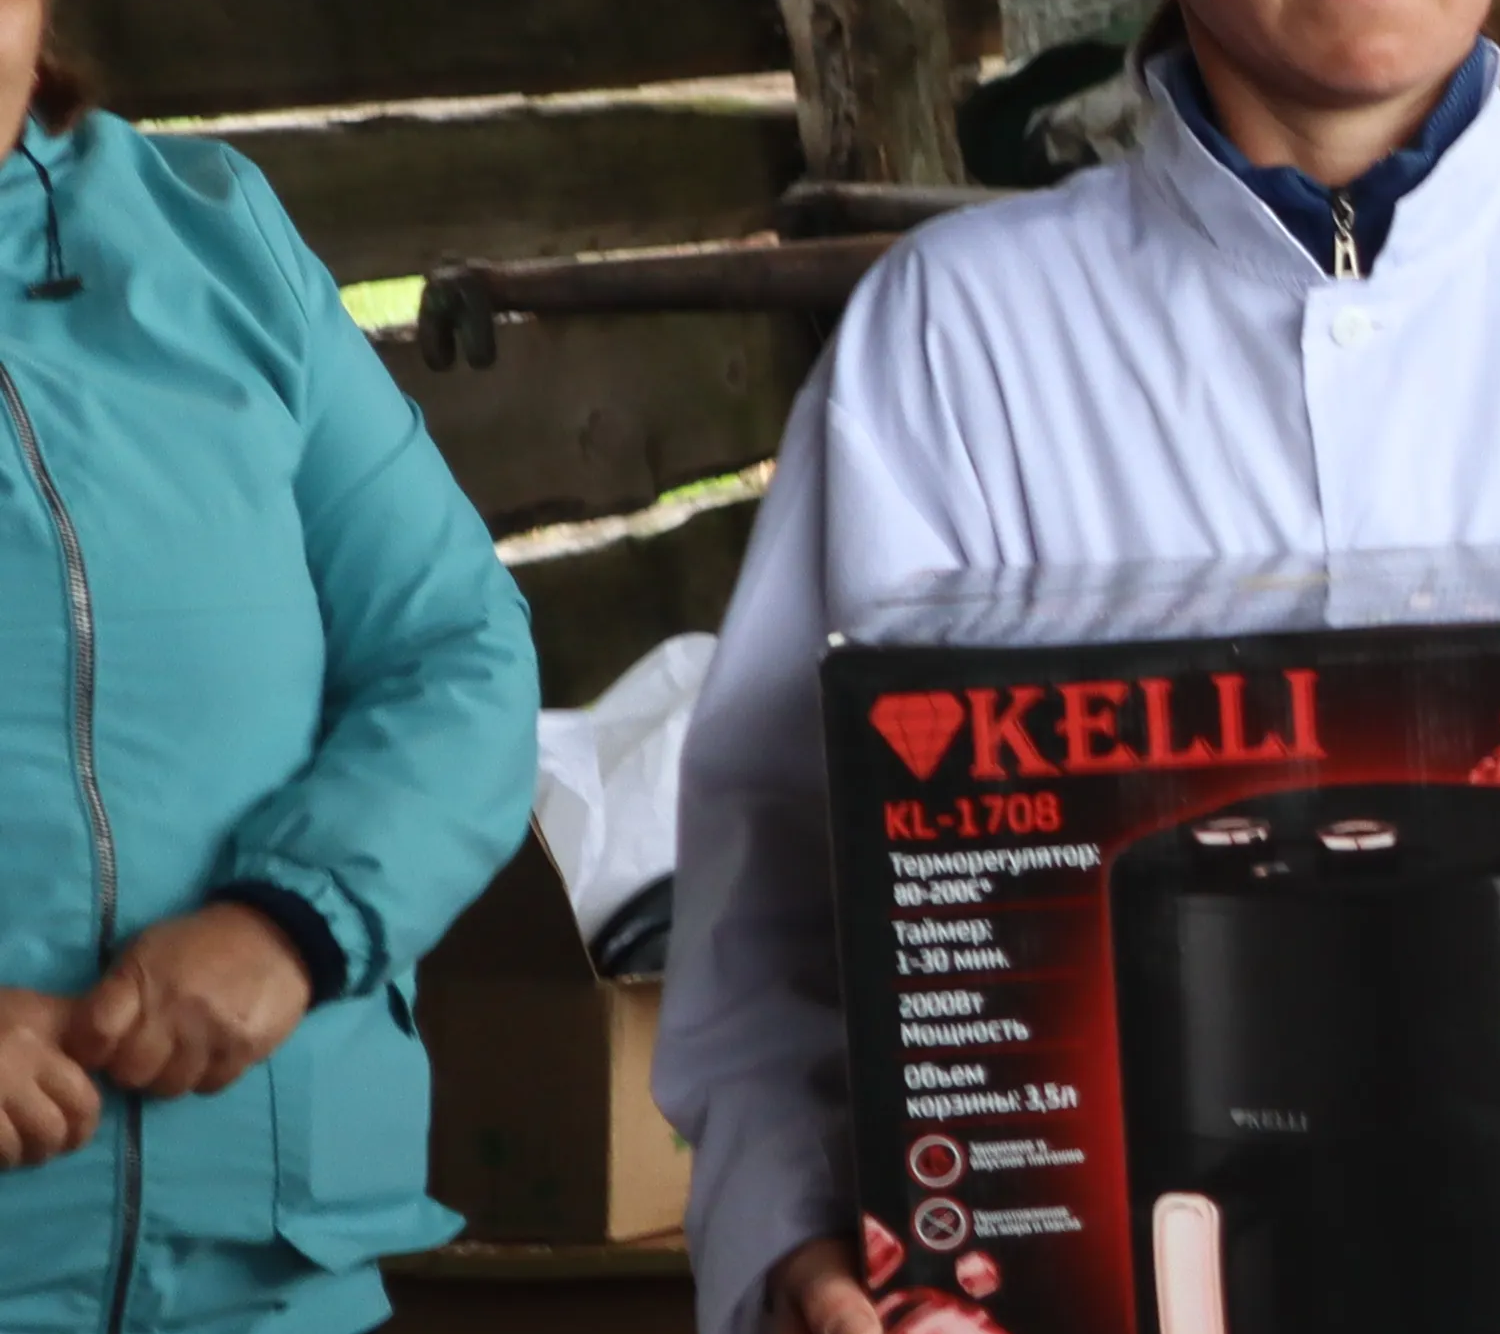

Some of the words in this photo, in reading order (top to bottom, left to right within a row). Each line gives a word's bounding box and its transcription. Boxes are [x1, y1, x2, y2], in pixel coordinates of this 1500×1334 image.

[965, 668, 1327, 780] KELLI
[884, 791, 1062, 840] KL-1708
[888, 843, 1101, 881] Терморегулятор:
[891, 917, 993, 947] Таймер:
[896, 947, 949, 975] 1-30
[898, 990, 985, 1019] 2000Вт
[901, 1019, 1031, 1047] Мощность
